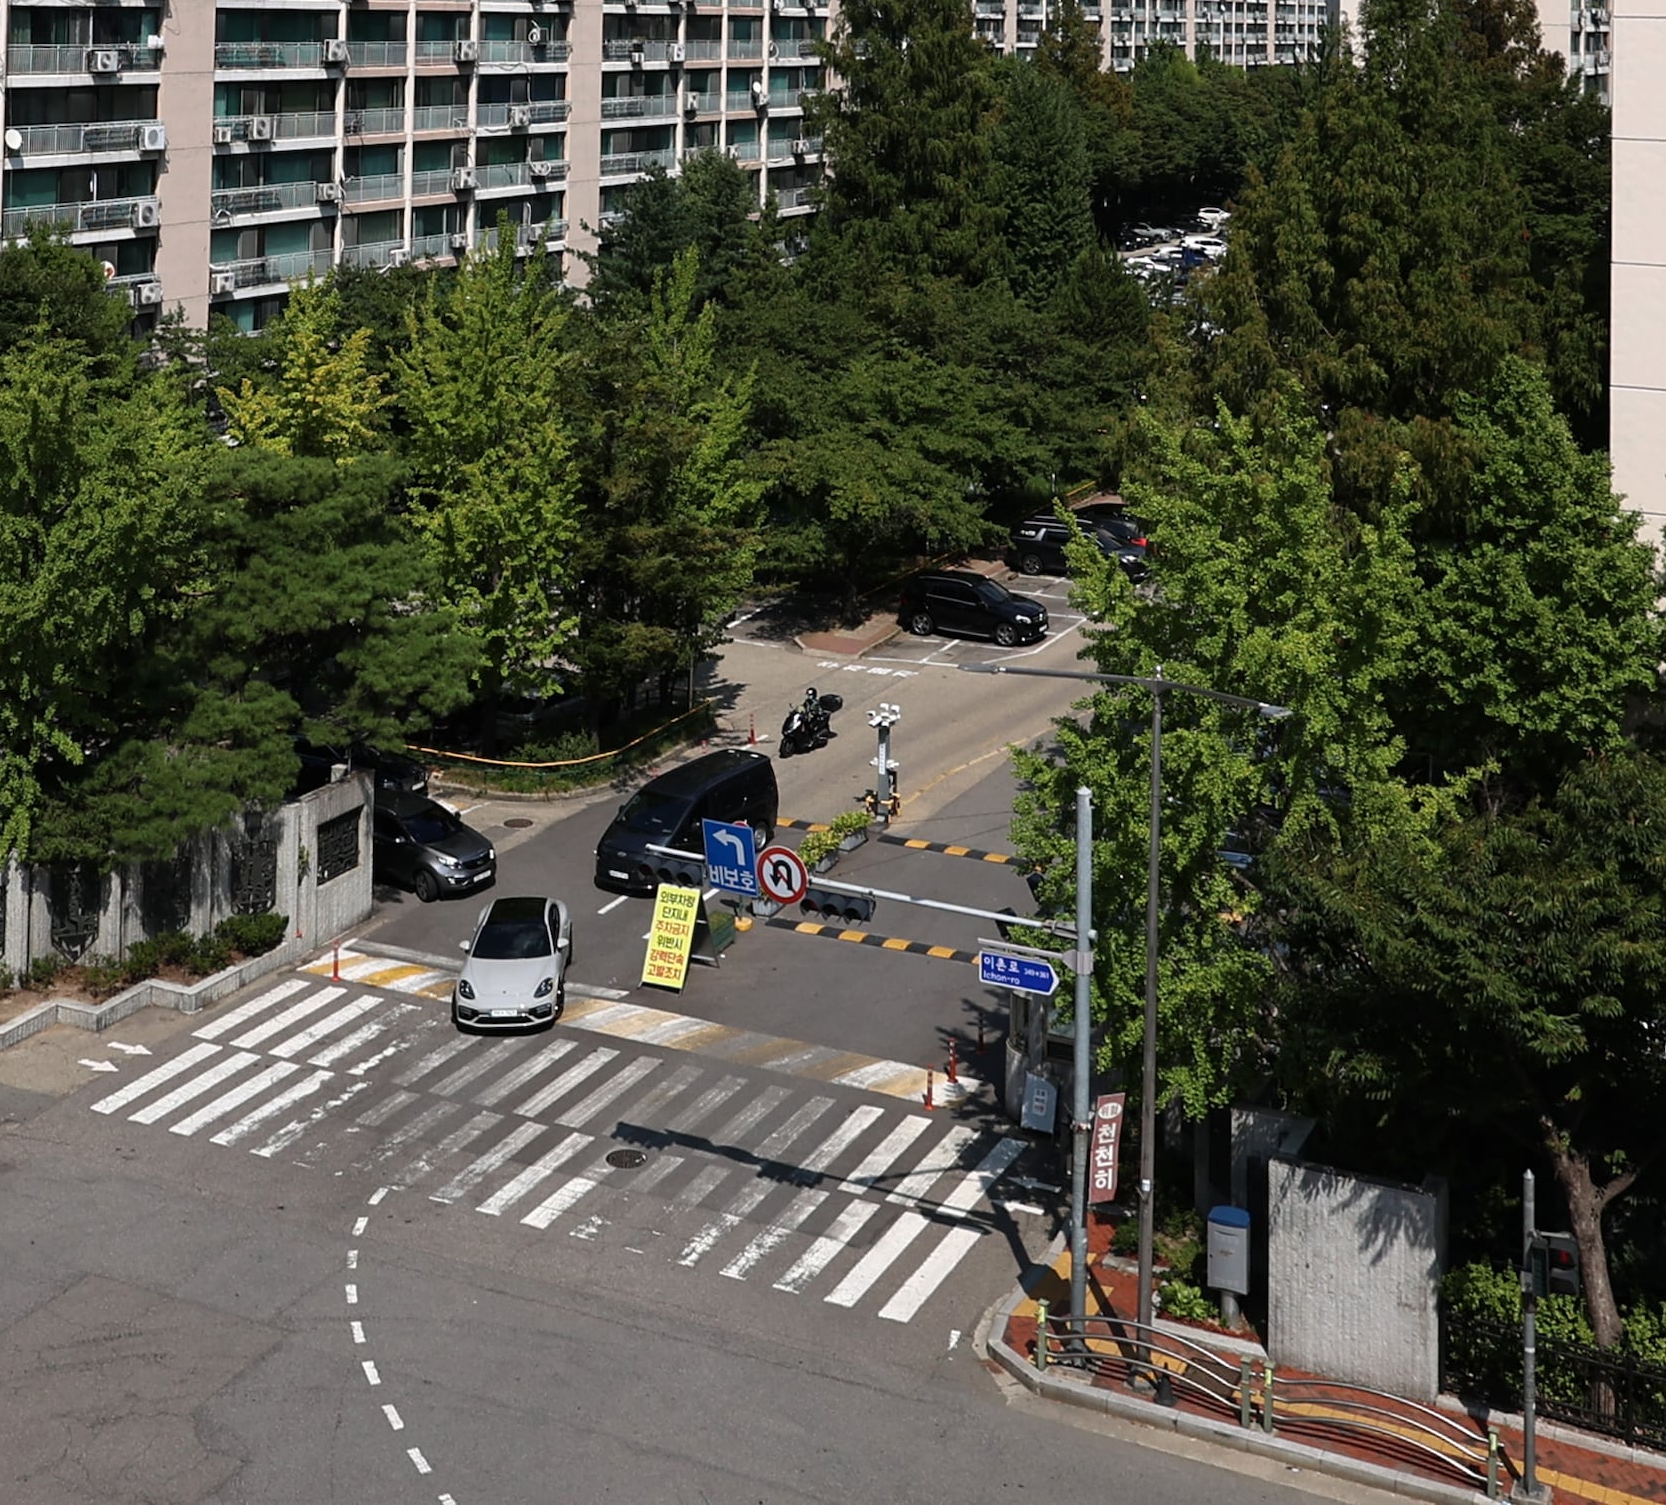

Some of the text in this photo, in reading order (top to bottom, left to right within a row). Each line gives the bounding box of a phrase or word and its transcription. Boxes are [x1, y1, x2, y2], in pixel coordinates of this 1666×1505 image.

[708, 864, 756, 892] 비보호
[660, 891, 695, 908] 외부차량
[662, 906, 689, 922] 단지내
[655, 920, 690, 937] 주차금지
[657, 935, 683, 951] 위반시
[983, 956, 1020, 974] 이촌로
[983, 970, 1020, 985] Ichon-ro
[1094, 1122, 1117, 1190] 천천히
